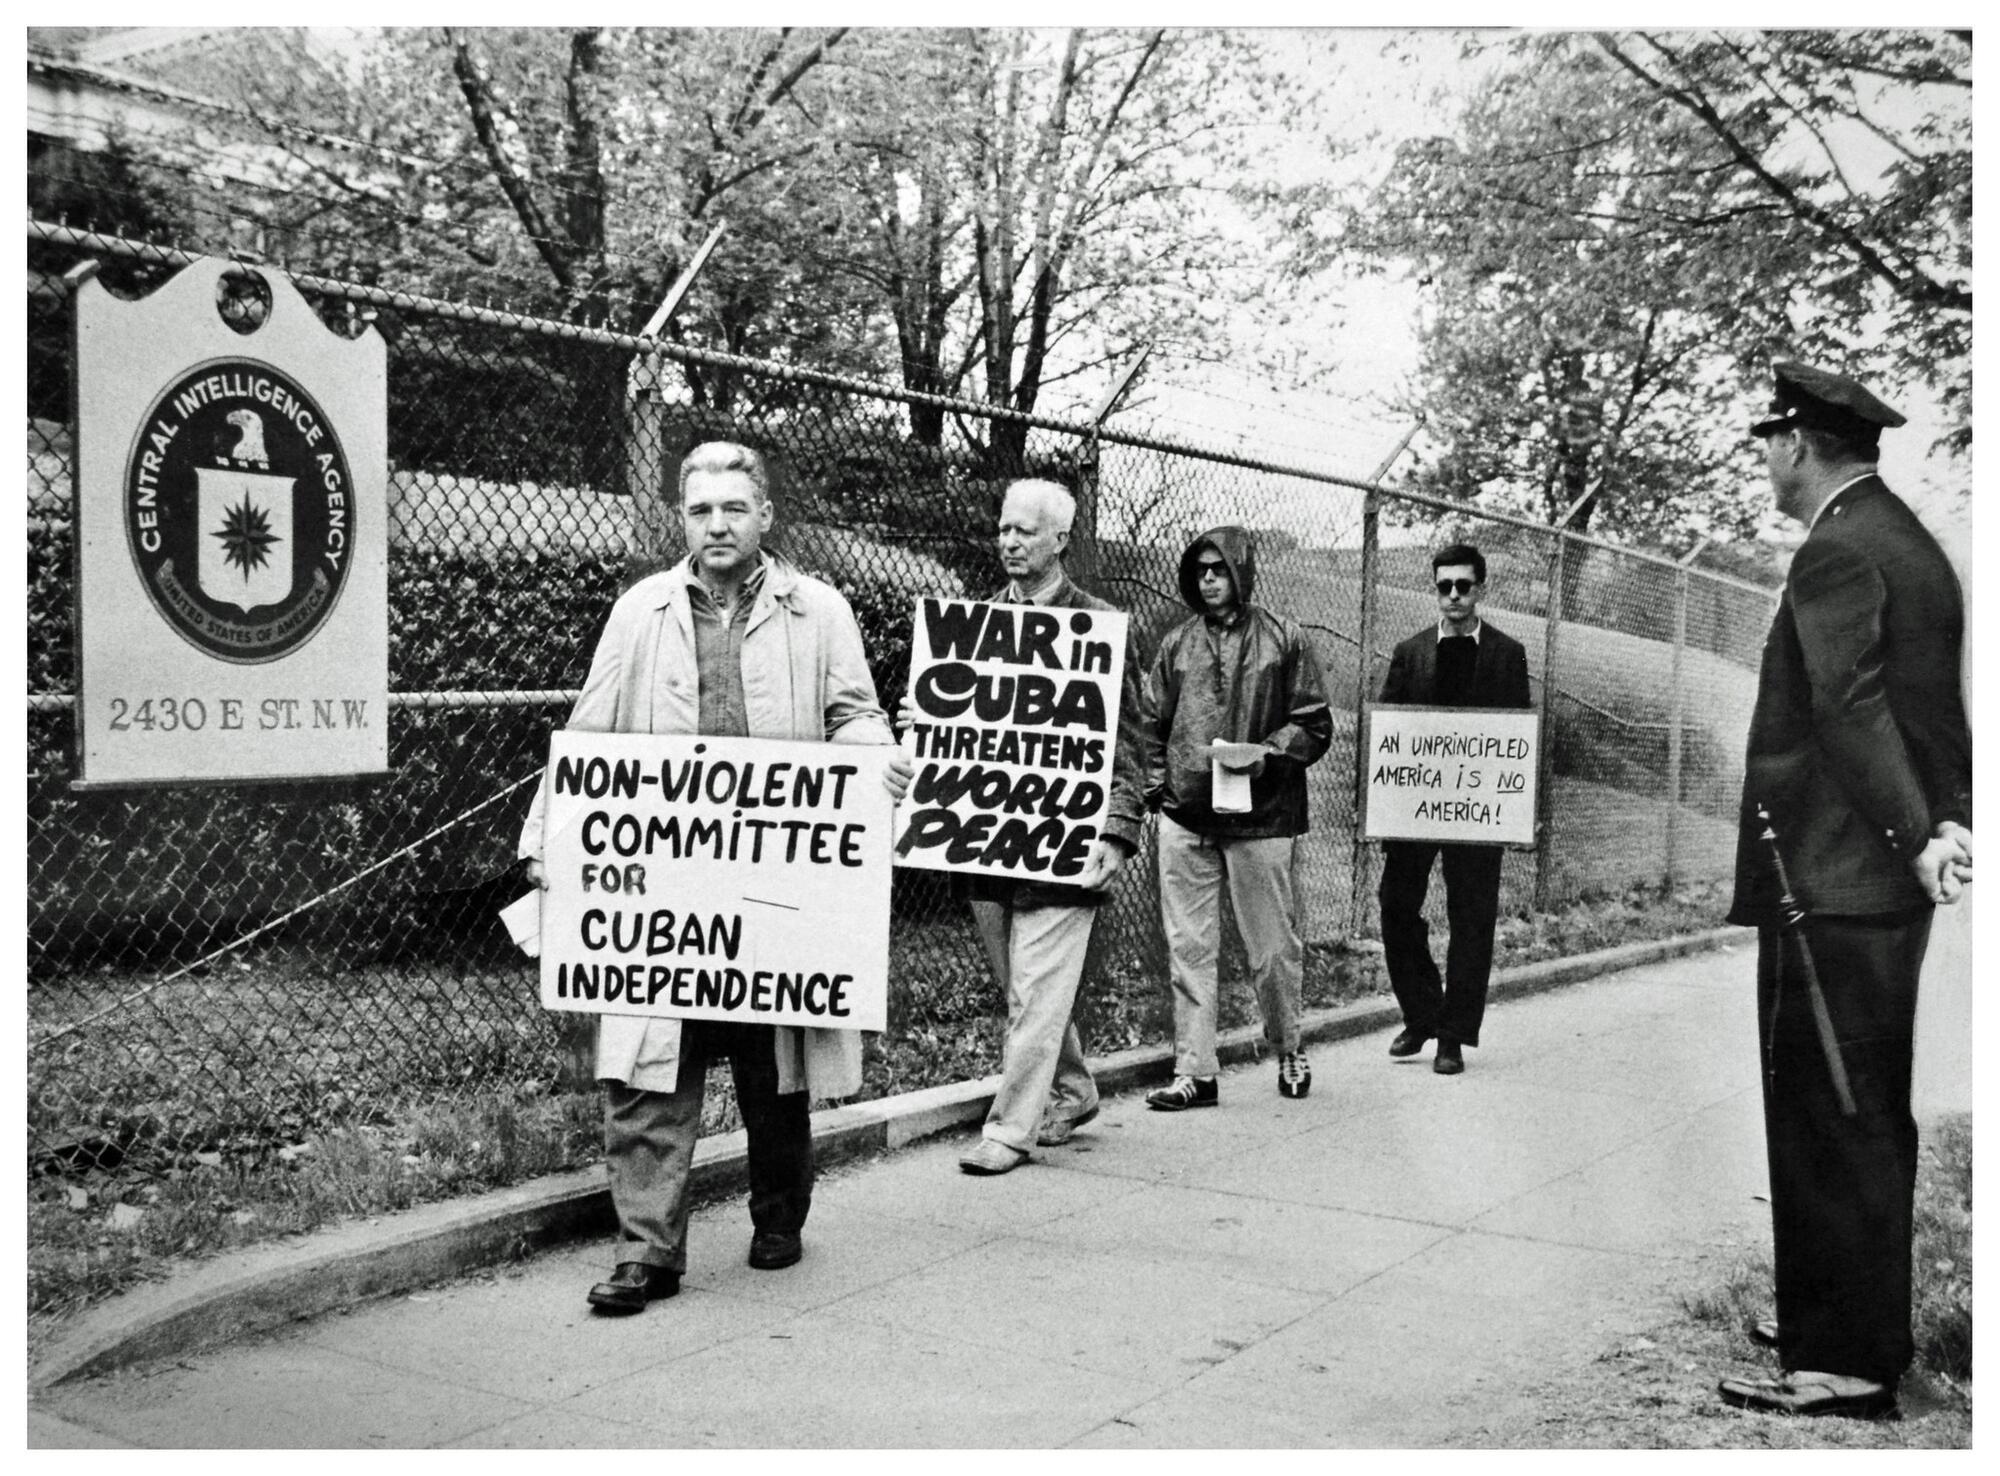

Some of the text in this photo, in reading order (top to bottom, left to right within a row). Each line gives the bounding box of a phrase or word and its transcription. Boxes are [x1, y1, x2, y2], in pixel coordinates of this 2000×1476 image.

[137, 373, 346, 570] CENTRAL INTELLIGENCE AGENCY
[165, 578, 325, 644] UNITED STATES OF AMERICA
[924, 598, 1112, 674] WAR in
[109, 698, 207, 732] 2430
[219, 699, 244, 730] E
[258, 698, 302, 730] ST.
[915, 662, 1107, 732] CUBA
[914, 723, 1105, 774] THREATENS
[1379, 732, 1400, 755] AN
[913, 763, 1104, 820] WORLD
[1497, 771, 1525, 793] NO
[894, 808, 1096, 877] PEACE
[582, 863, 646, 895] FOR
[581, 908, 742, 960] CUBAN
[558, 963, 854, 1017] INDEPENDENCE
